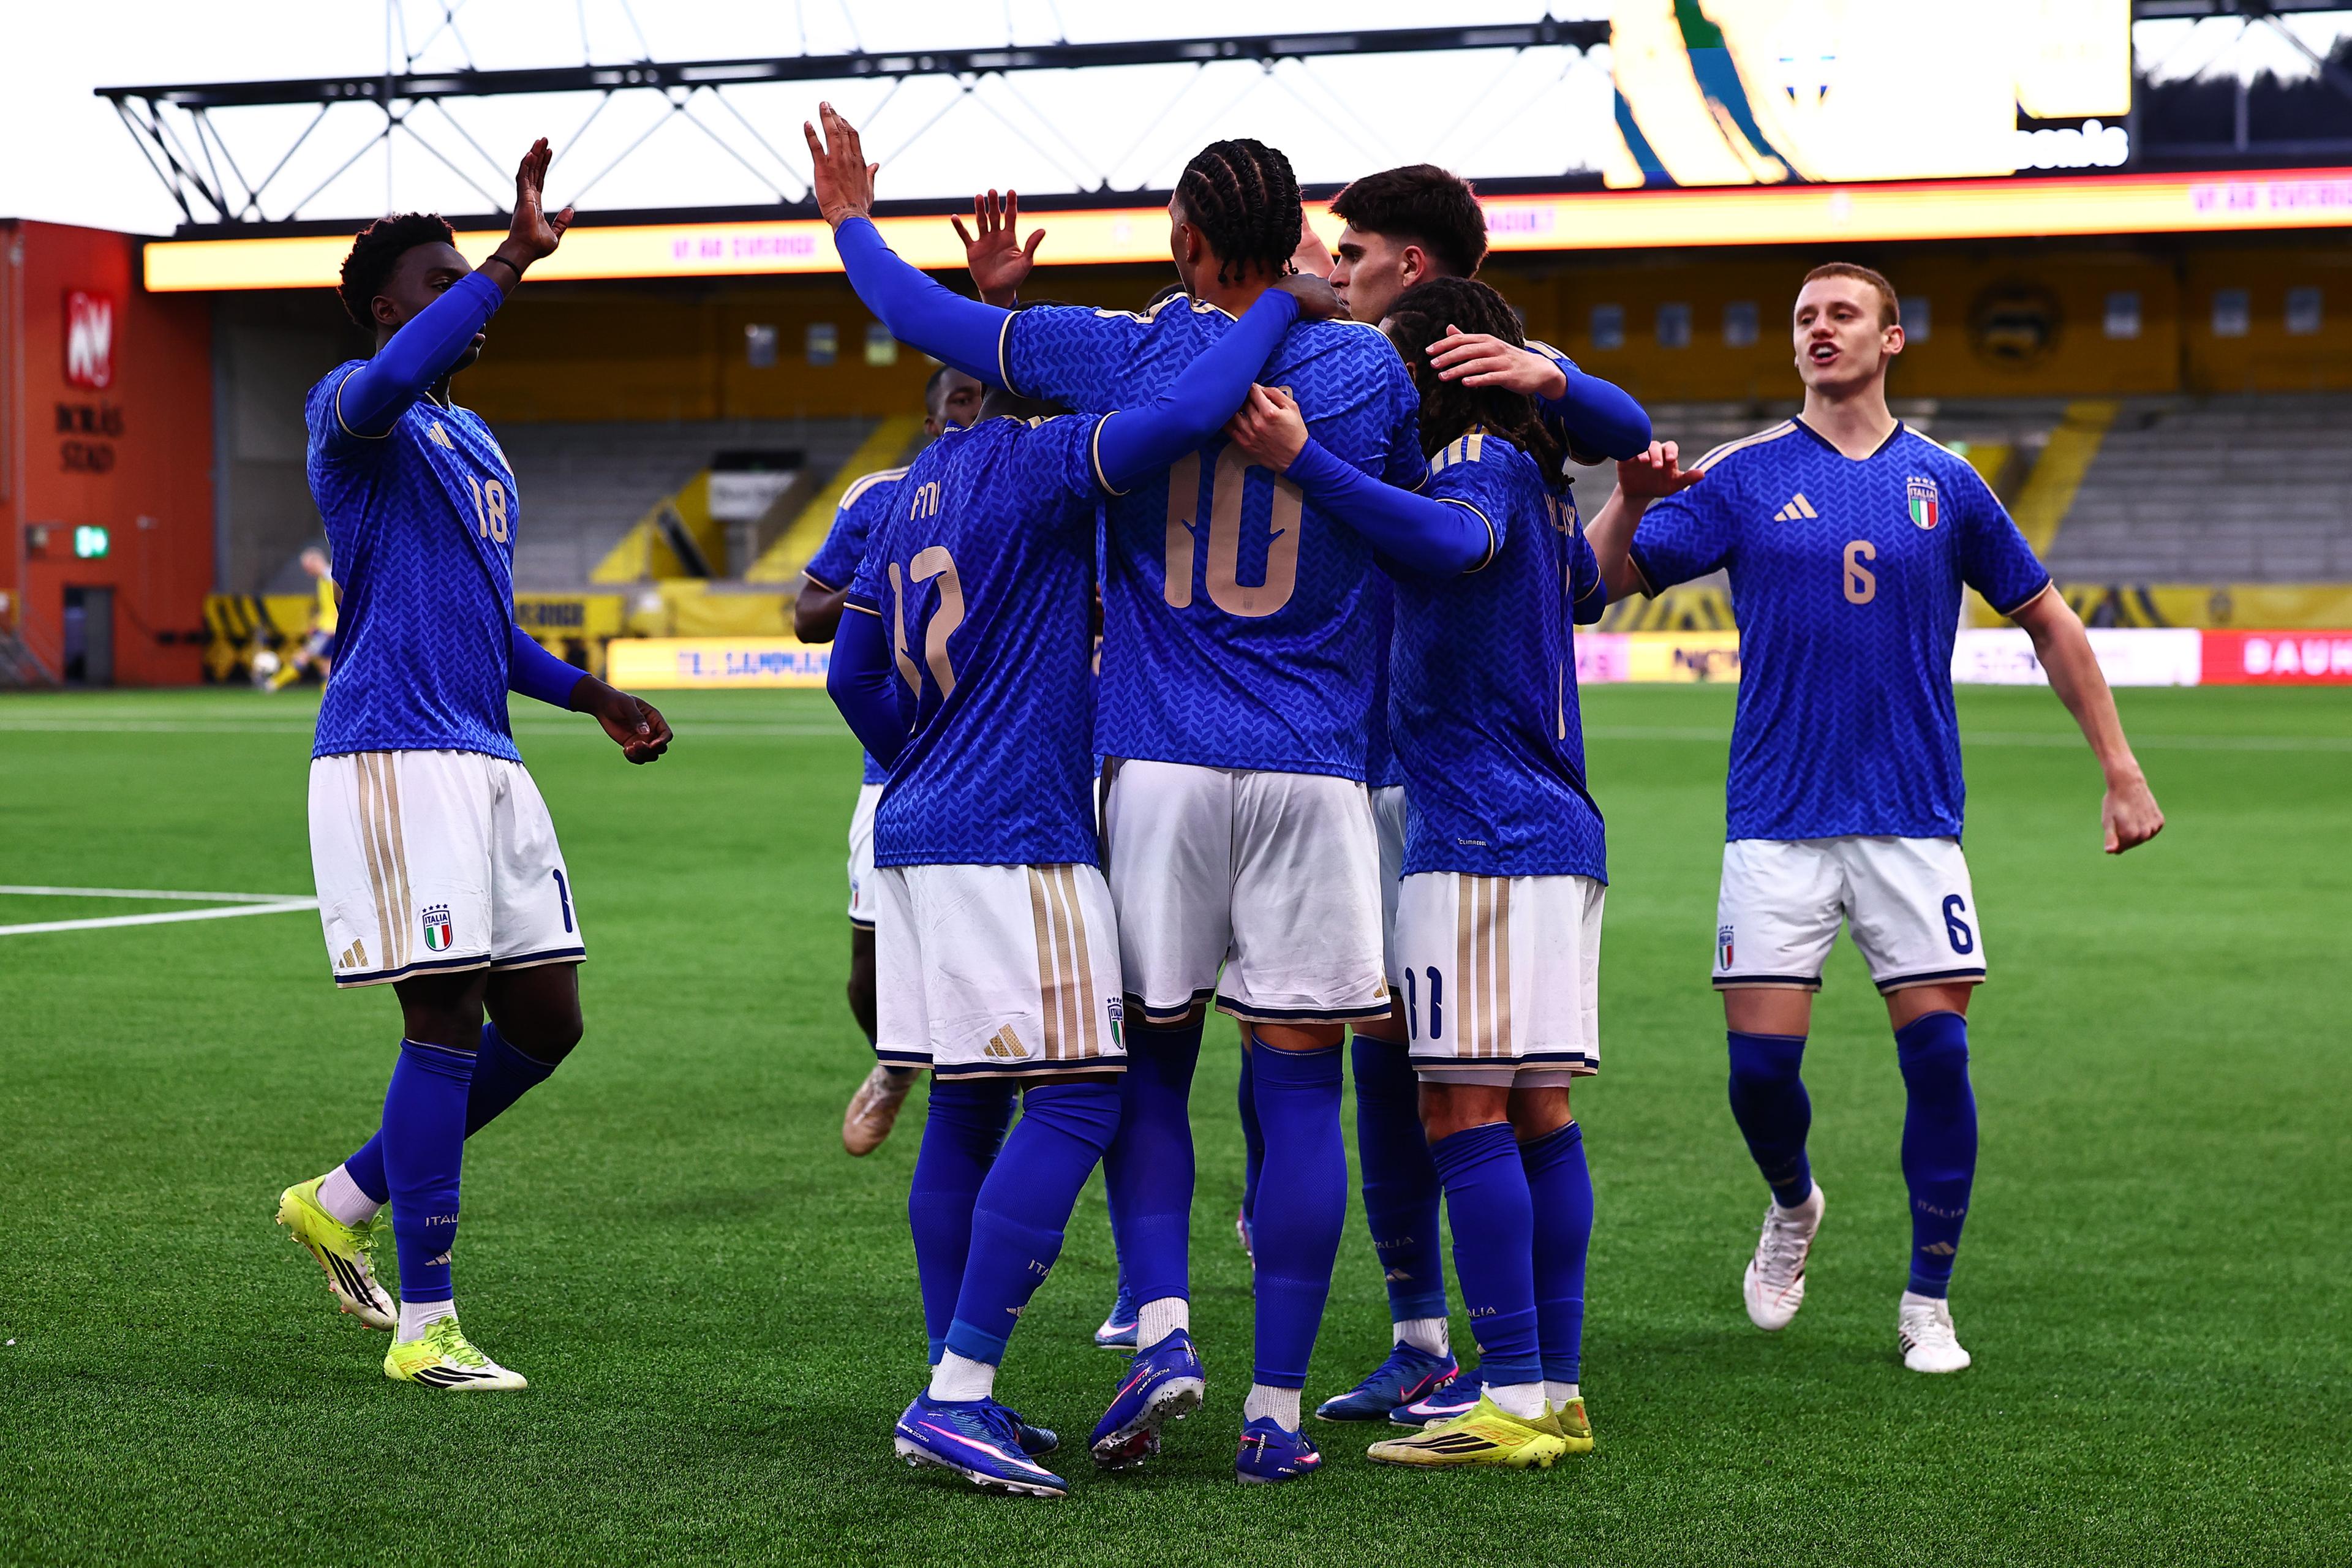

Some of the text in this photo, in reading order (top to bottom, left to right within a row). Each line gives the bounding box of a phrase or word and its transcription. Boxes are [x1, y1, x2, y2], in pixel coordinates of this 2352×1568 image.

[467, 475, 507, 543] 18
[1164, 442, 1303, 617] 10
[1844, 540, 1876, 605] 6
[425, 913, 448, 924] ITALIA
[1942, 894, 1973, 954] 6
[1405, 966, 1442, 1040] 11
